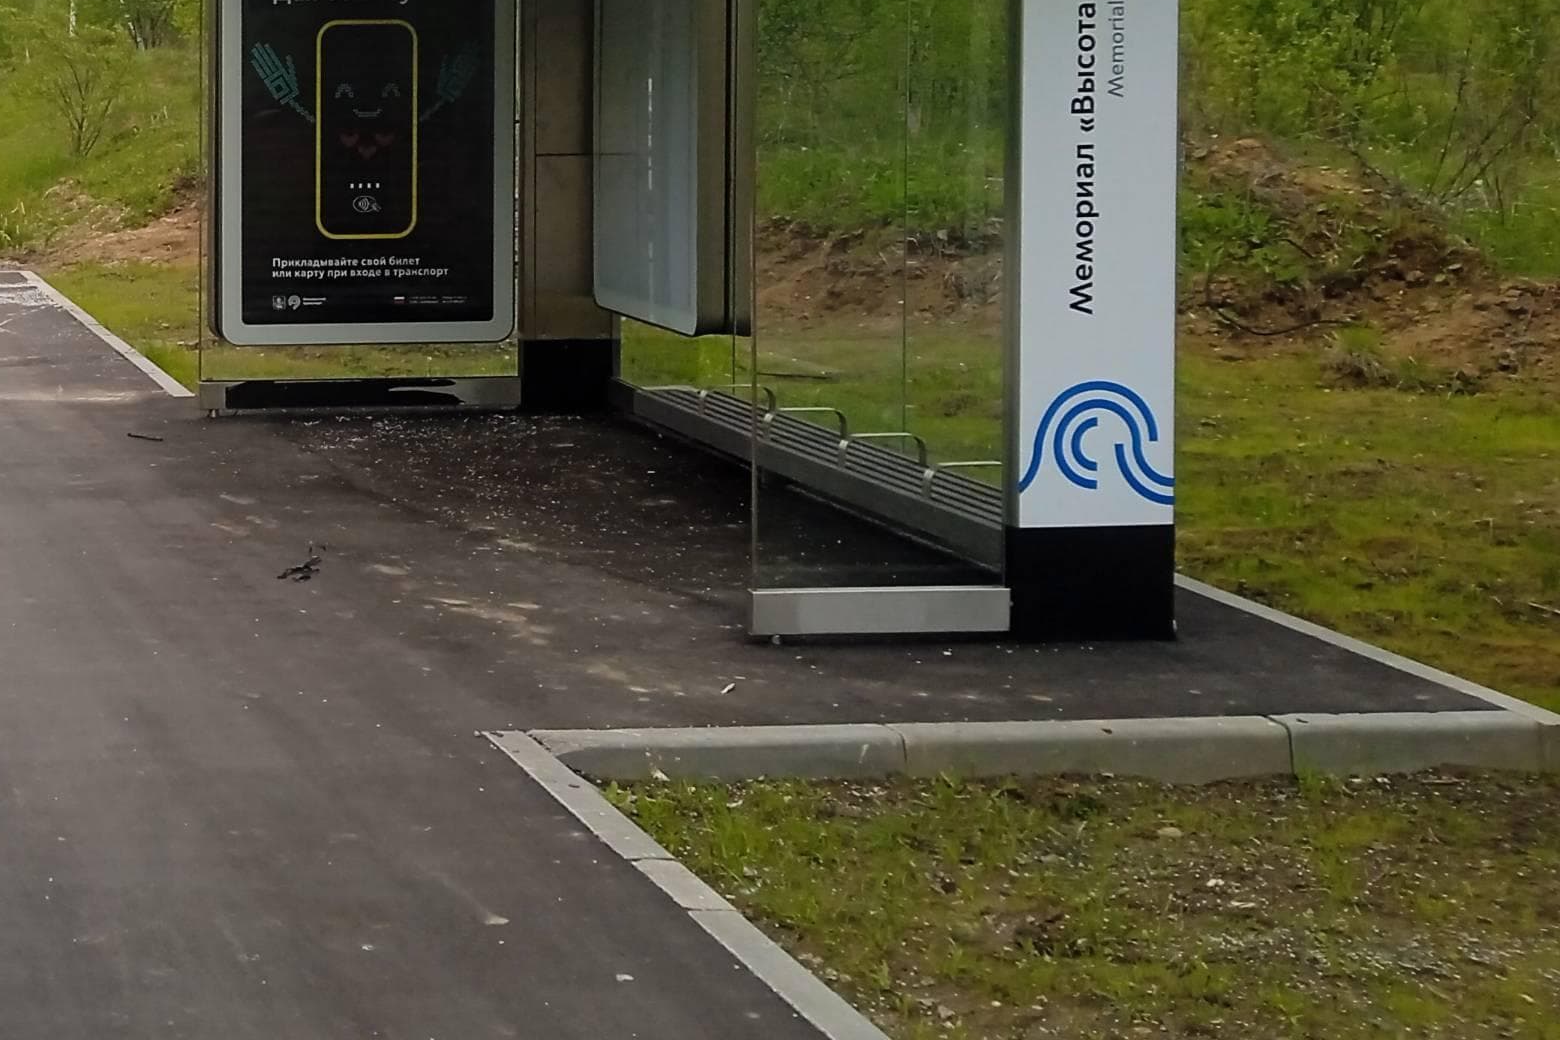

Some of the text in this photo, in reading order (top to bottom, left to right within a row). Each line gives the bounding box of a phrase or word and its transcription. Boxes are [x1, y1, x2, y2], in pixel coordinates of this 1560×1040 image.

[1070, 2, 1097, 133] «Высота
[1107, 0, 1126, 98] Memorial
[271, 256, 420, 269] Прикладывайте свой билет
[271, 269, 292, 278] или
[294, 269, 325, 280] карту
[327, 269, 348, 279] при
[350, 268, 382, 278] входе
[393, 267, 449, 279] транспорт
[1068, 143, 1100, 316] Мемориал
